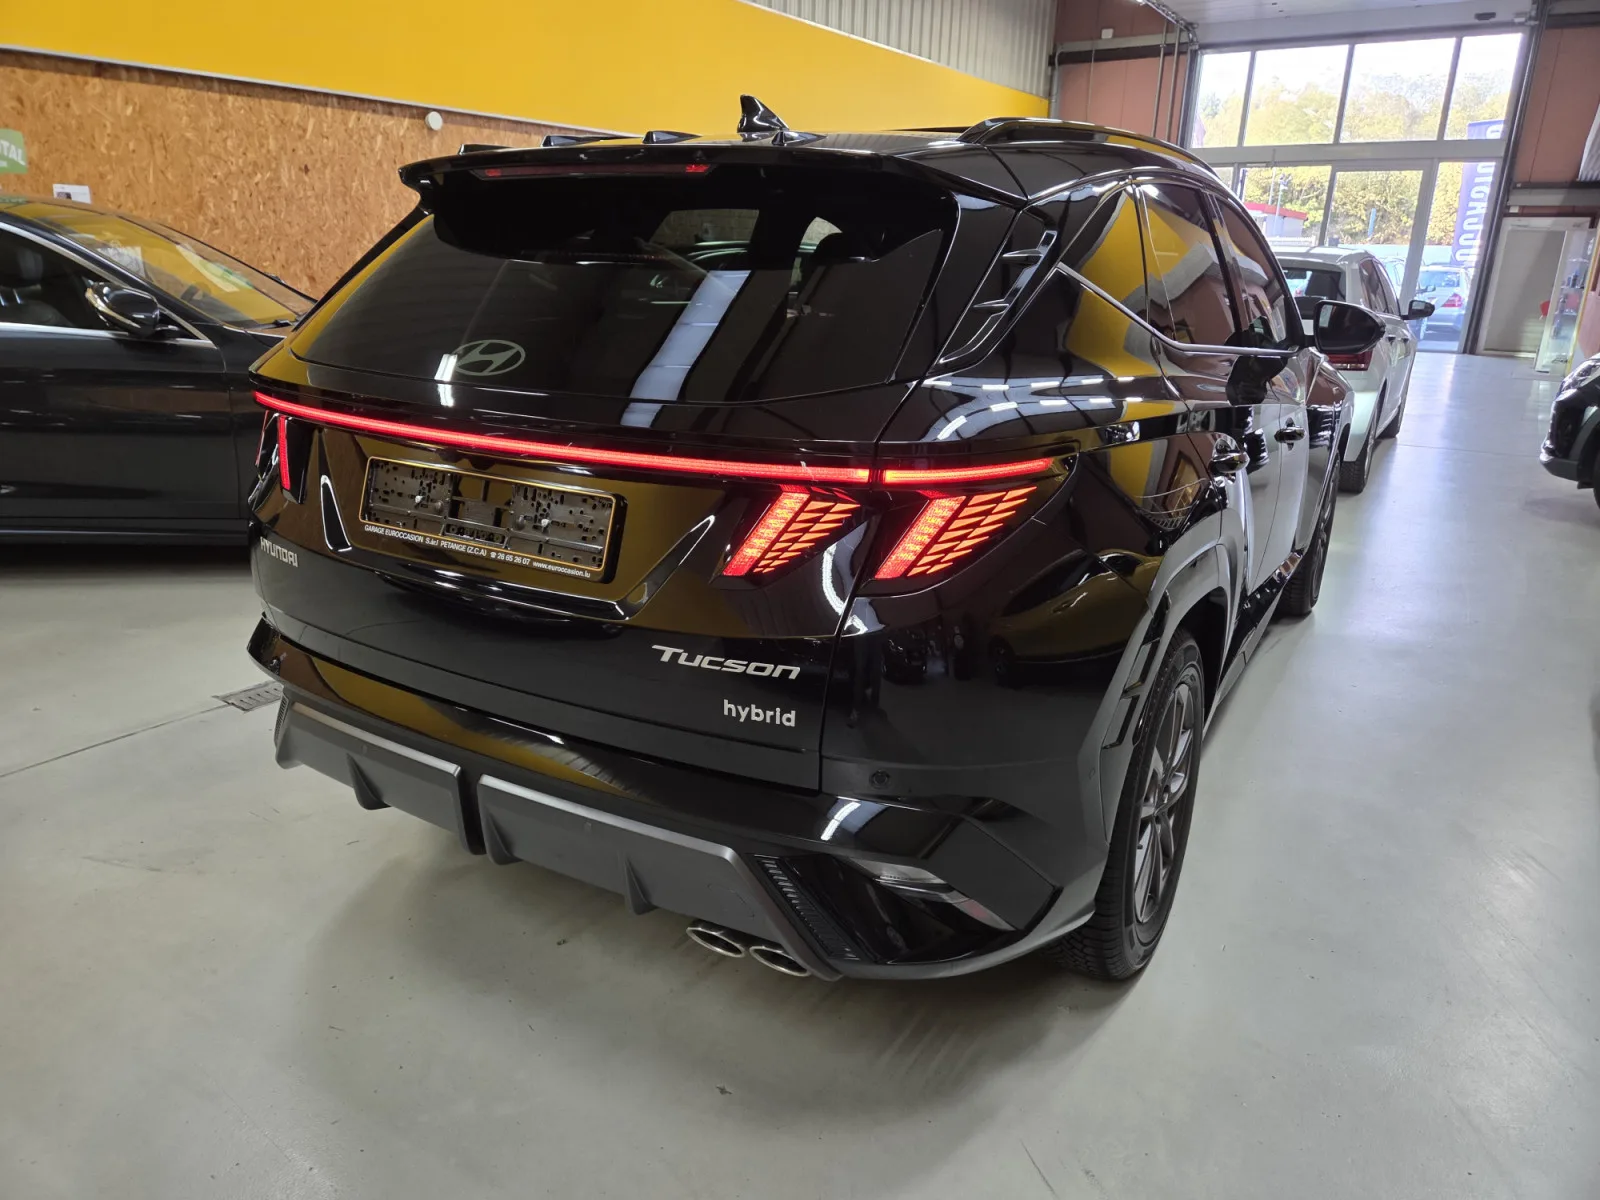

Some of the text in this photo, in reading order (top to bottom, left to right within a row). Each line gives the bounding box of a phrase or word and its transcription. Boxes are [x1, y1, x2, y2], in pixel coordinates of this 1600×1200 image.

[0, 139, 26, 166] TAL
[260, 536, 299, 568] HYUNDAI
[364, 524, 385, 535] GARAGE
[385, 529, 424, 543] EUROCCASION
[440, 540, 467, 552] PETANGE
[497, 552, 505, 560] 26
[505, 553, 514, 562] 65
[514, 555, 522, 564] 26
[522, 557, 531, 566] 07
[532, 561, 591, 578] www.euroccasion.lu
[723, 698, 796, 728] hybrid
